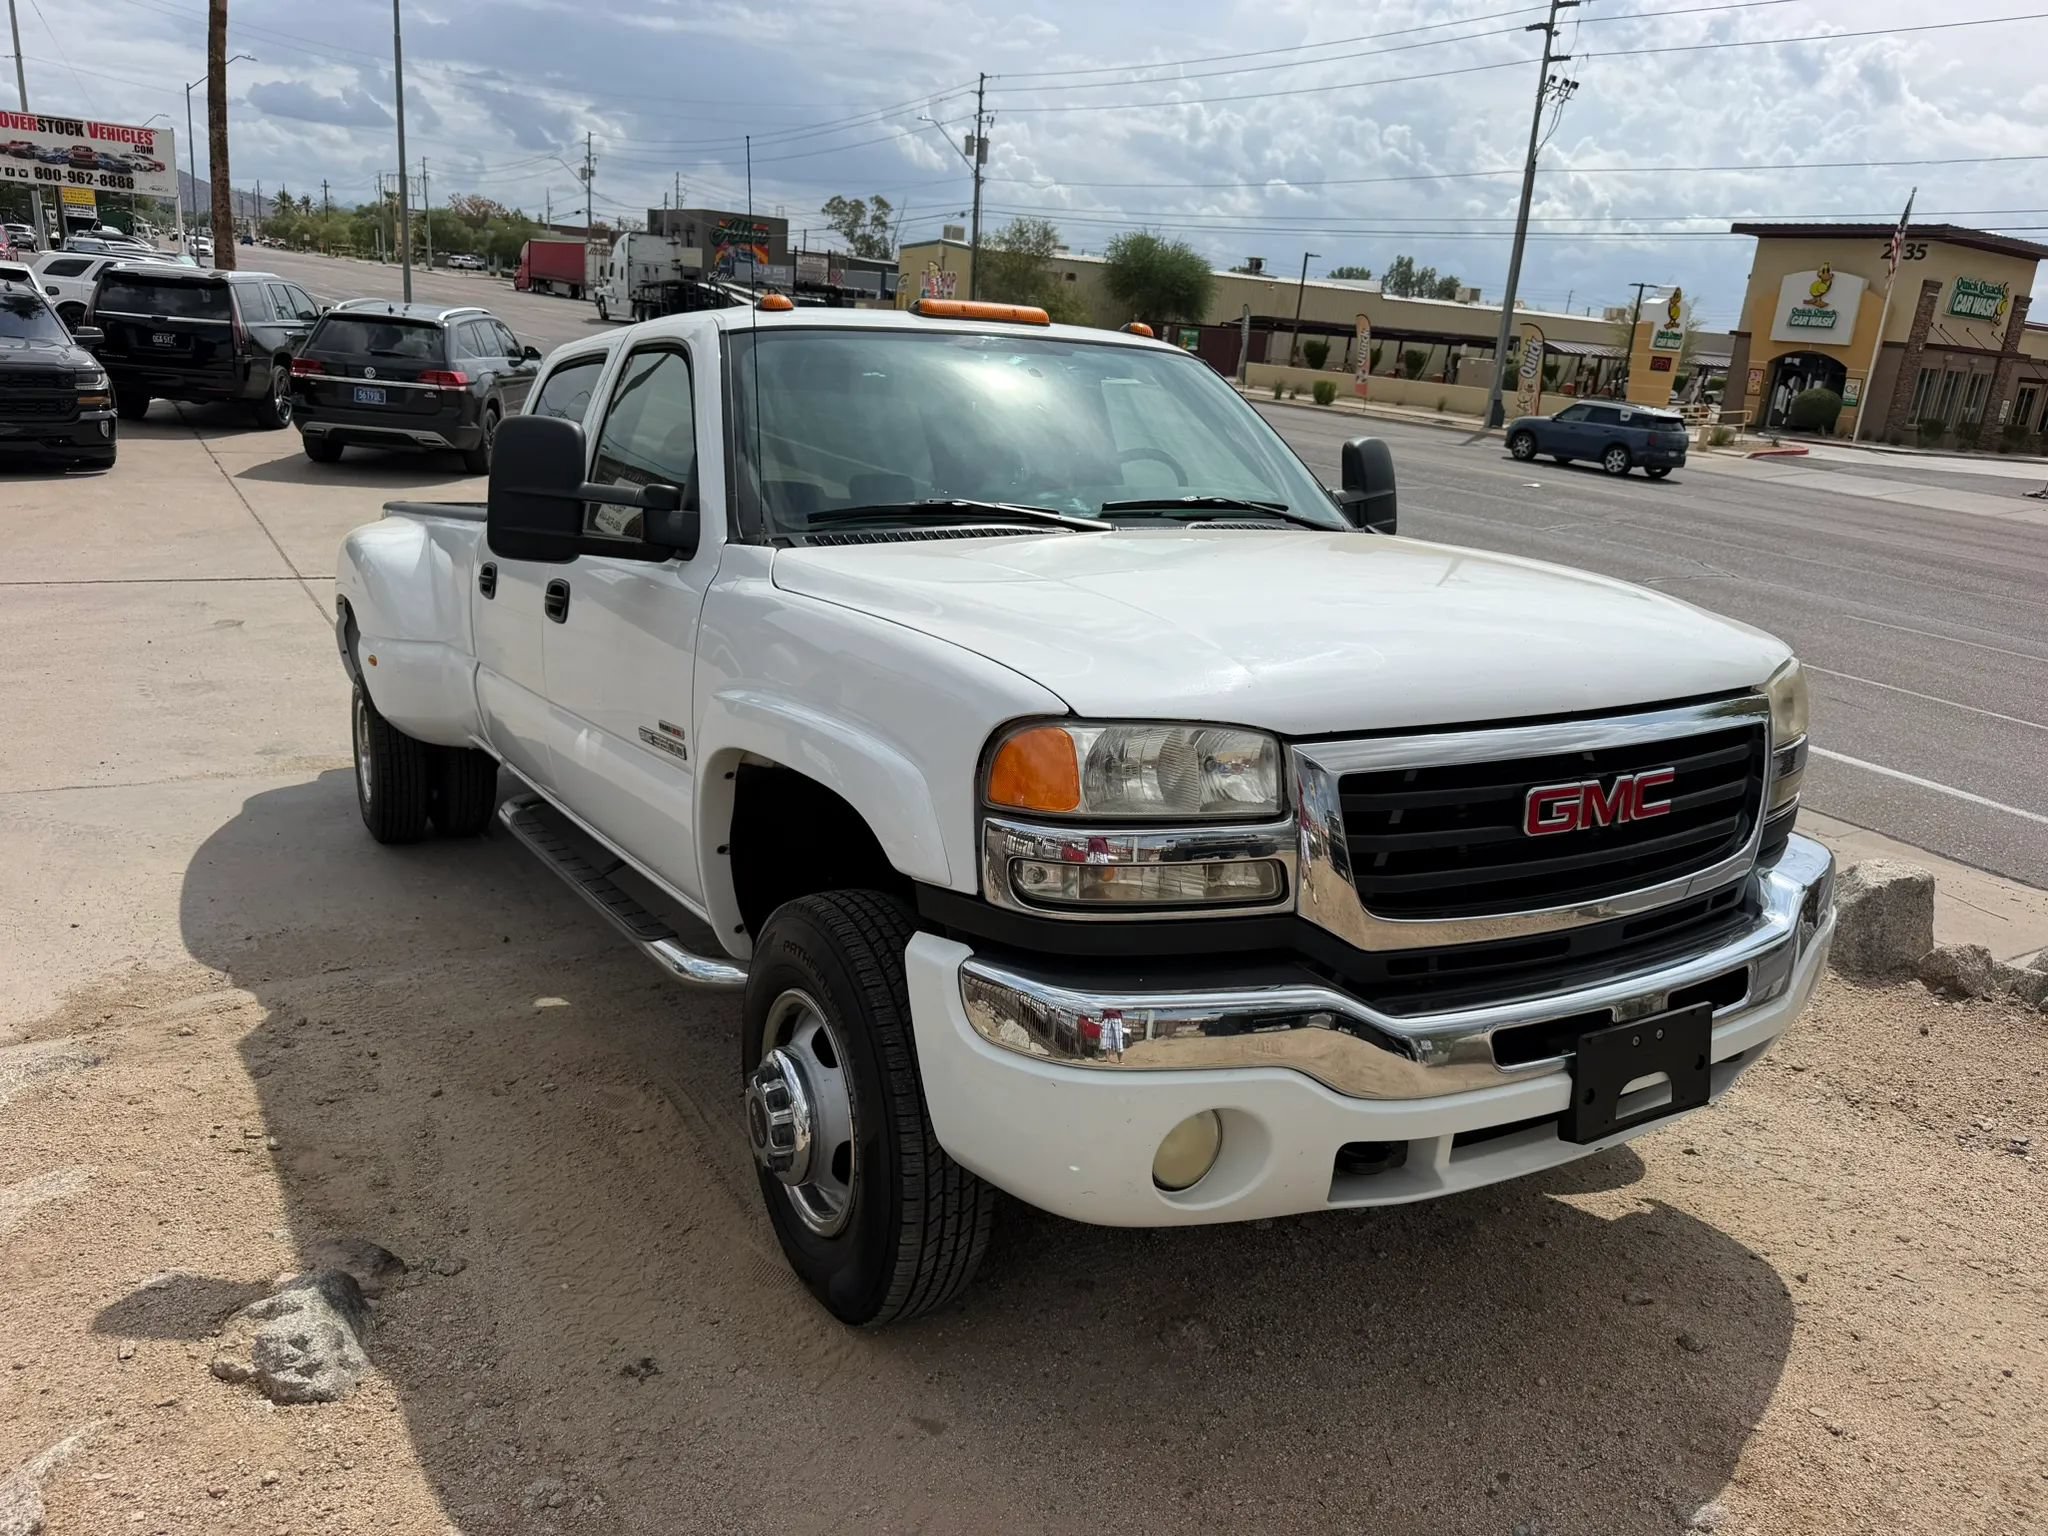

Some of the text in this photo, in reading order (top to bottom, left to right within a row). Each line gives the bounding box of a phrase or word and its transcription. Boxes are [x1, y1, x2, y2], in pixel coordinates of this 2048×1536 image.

[0, 111, 153, 146] OVERSTOCK VEHICLES
[34, 166, 134, 190] 800-962-8888
[1880, 242, 1928, 260] 235
[1956, 276, 1979, 293] Quick
[1953, 293, 2000, 317] CAR WASH
[1791, 315, 1836, 327] CAR WASH
[1519, 335, 1543, 378] Quick
[1523, 767, 1675, 837] GMC
